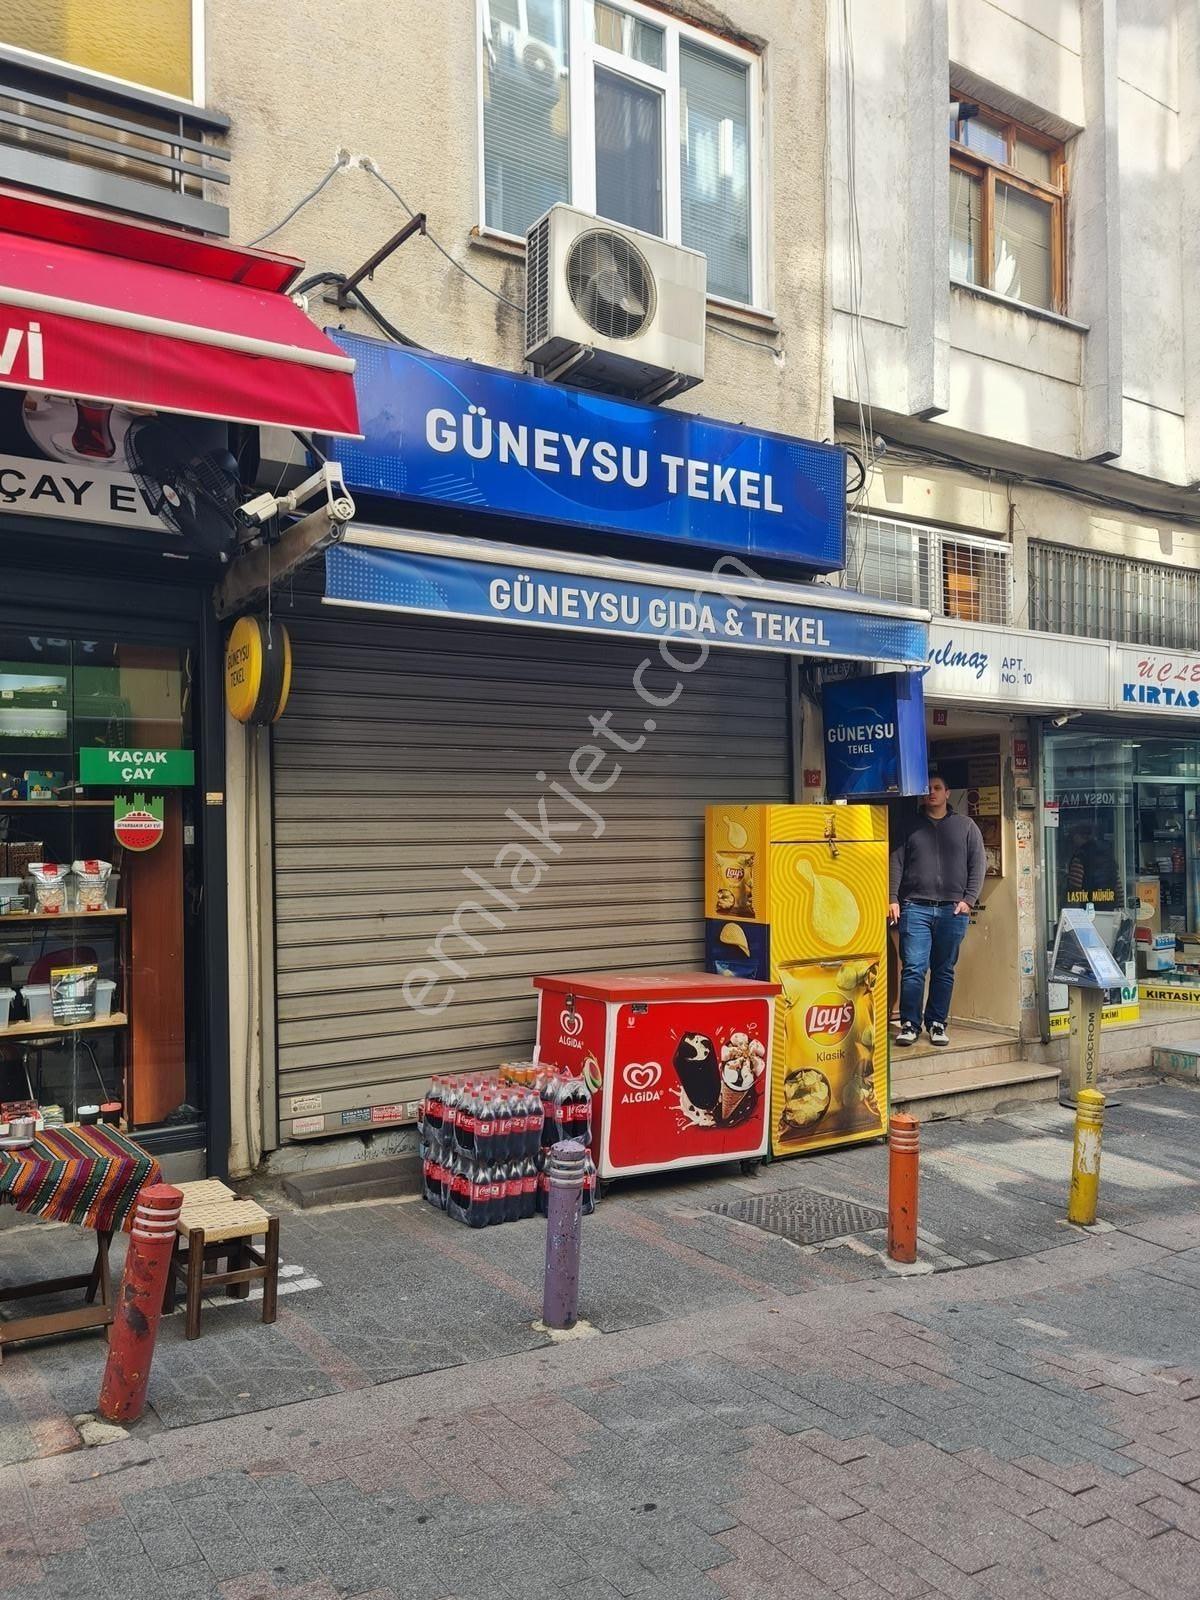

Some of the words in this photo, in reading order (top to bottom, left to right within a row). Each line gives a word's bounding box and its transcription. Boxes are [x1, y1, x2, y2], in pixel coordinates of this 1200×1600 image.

[425, 405, 649, 488] GÜNEYSU
[661, 454, 784, 513] TEKEL
[0, 469, 94, 506] ÇAY
[488, 574, 641, 626] GÜNEYSU
[648, 598, 716, 634] GIDA
[725, 607, 744, 637] &
[752, 612, 831, 647] TEKEL
[1002, 656, 1026, 672] APT.
[1023, 673, 1033, 685] 10
[1123, 683, 1200, 708] KIRTAS
[827, 722, 895, 743] GÜNEYSU
[108, 750, 168, 766] KAÇAK
[847, 743, 875, 755] TEKEL
[121, 767, 155, 782] ÇAY
[1067, 889, 1089, 902] LASTİK
[1092, 888, 1115, 902] MÜHÜR
[808, 1002, 853, 1035] Lay's
[816, 1049, 846, 1062] Klasik
[1086, 1012, 1096, 1084] INOXCROM
